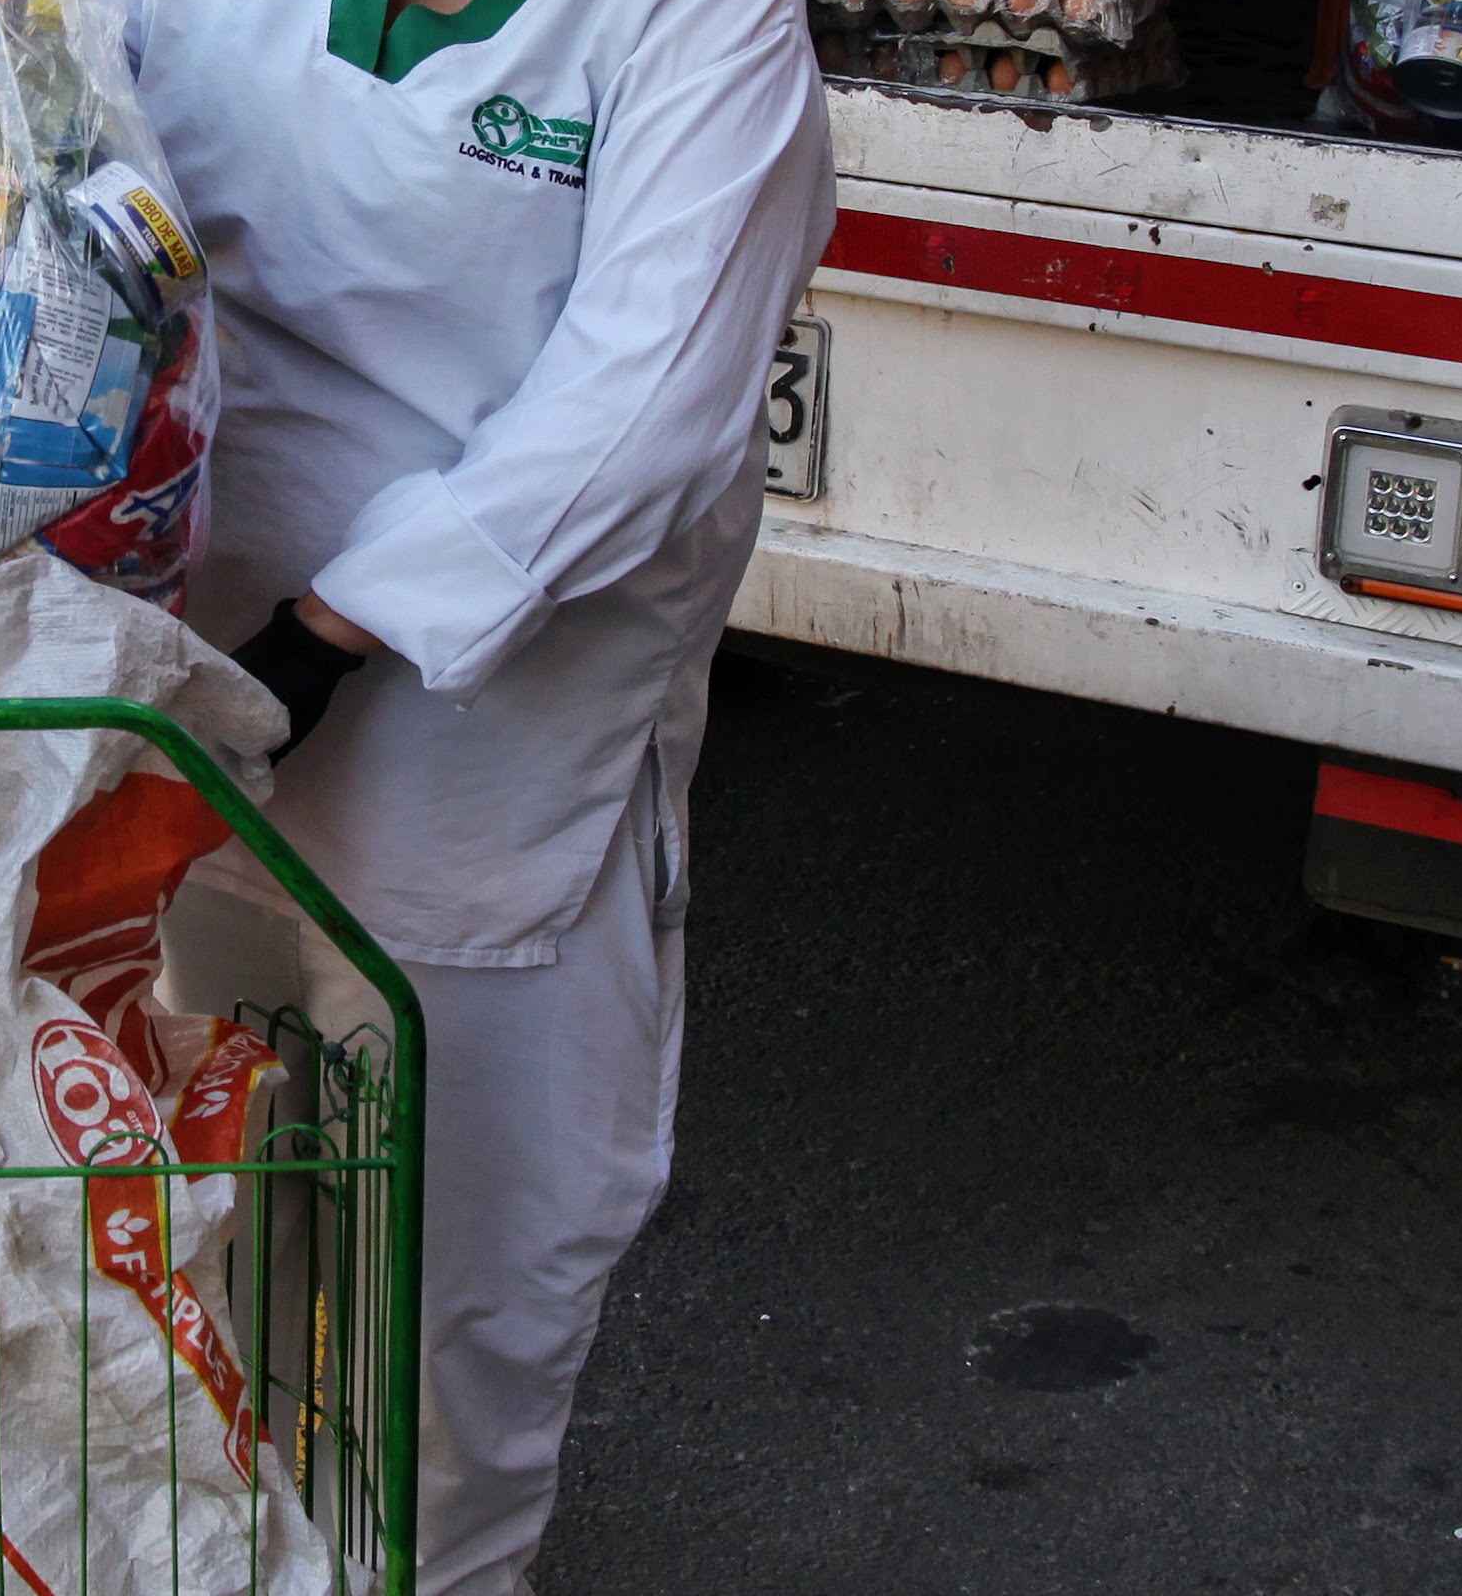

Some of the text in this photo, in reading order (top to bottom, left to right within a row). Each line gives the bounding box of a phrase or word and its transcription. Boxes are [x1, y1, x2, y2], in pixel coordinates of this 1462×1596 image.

[459, 142, 525, 175] LOGISTICA
[531, 166, 541, 179] &
[131, 189, 162, 223] LOBO
[157, 222, 177, 243] DE
[168, 242, 194, 275] MAR
[141, 227, 160, 253] TUNA
